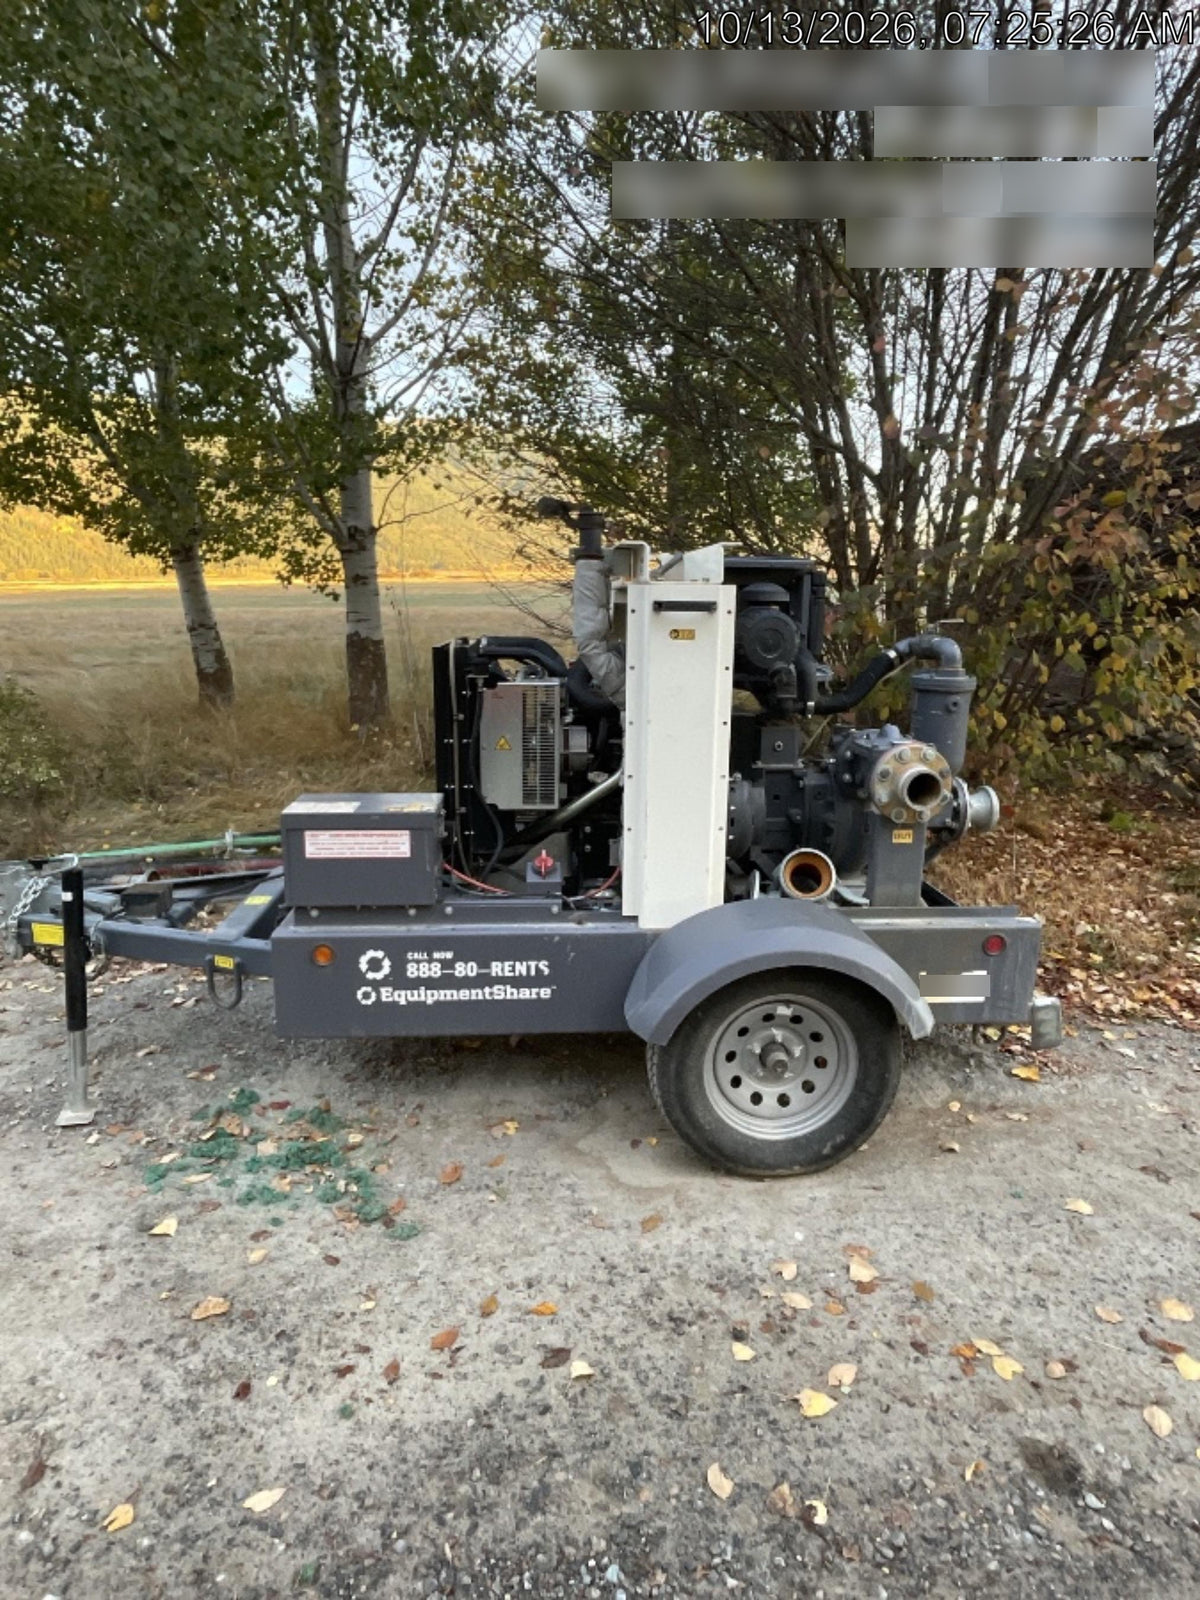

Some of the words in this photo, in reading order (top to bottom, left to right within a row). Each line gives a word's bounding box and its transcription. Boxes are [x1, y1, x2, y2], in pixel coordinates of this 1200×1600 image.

[406, 951, 429, 960] CALL
[433, 951, 454, 960] NOW
[406, 960, 550, 978] 888-80-RENTS
[379, 984, 552, 1005] EquipmentShare
